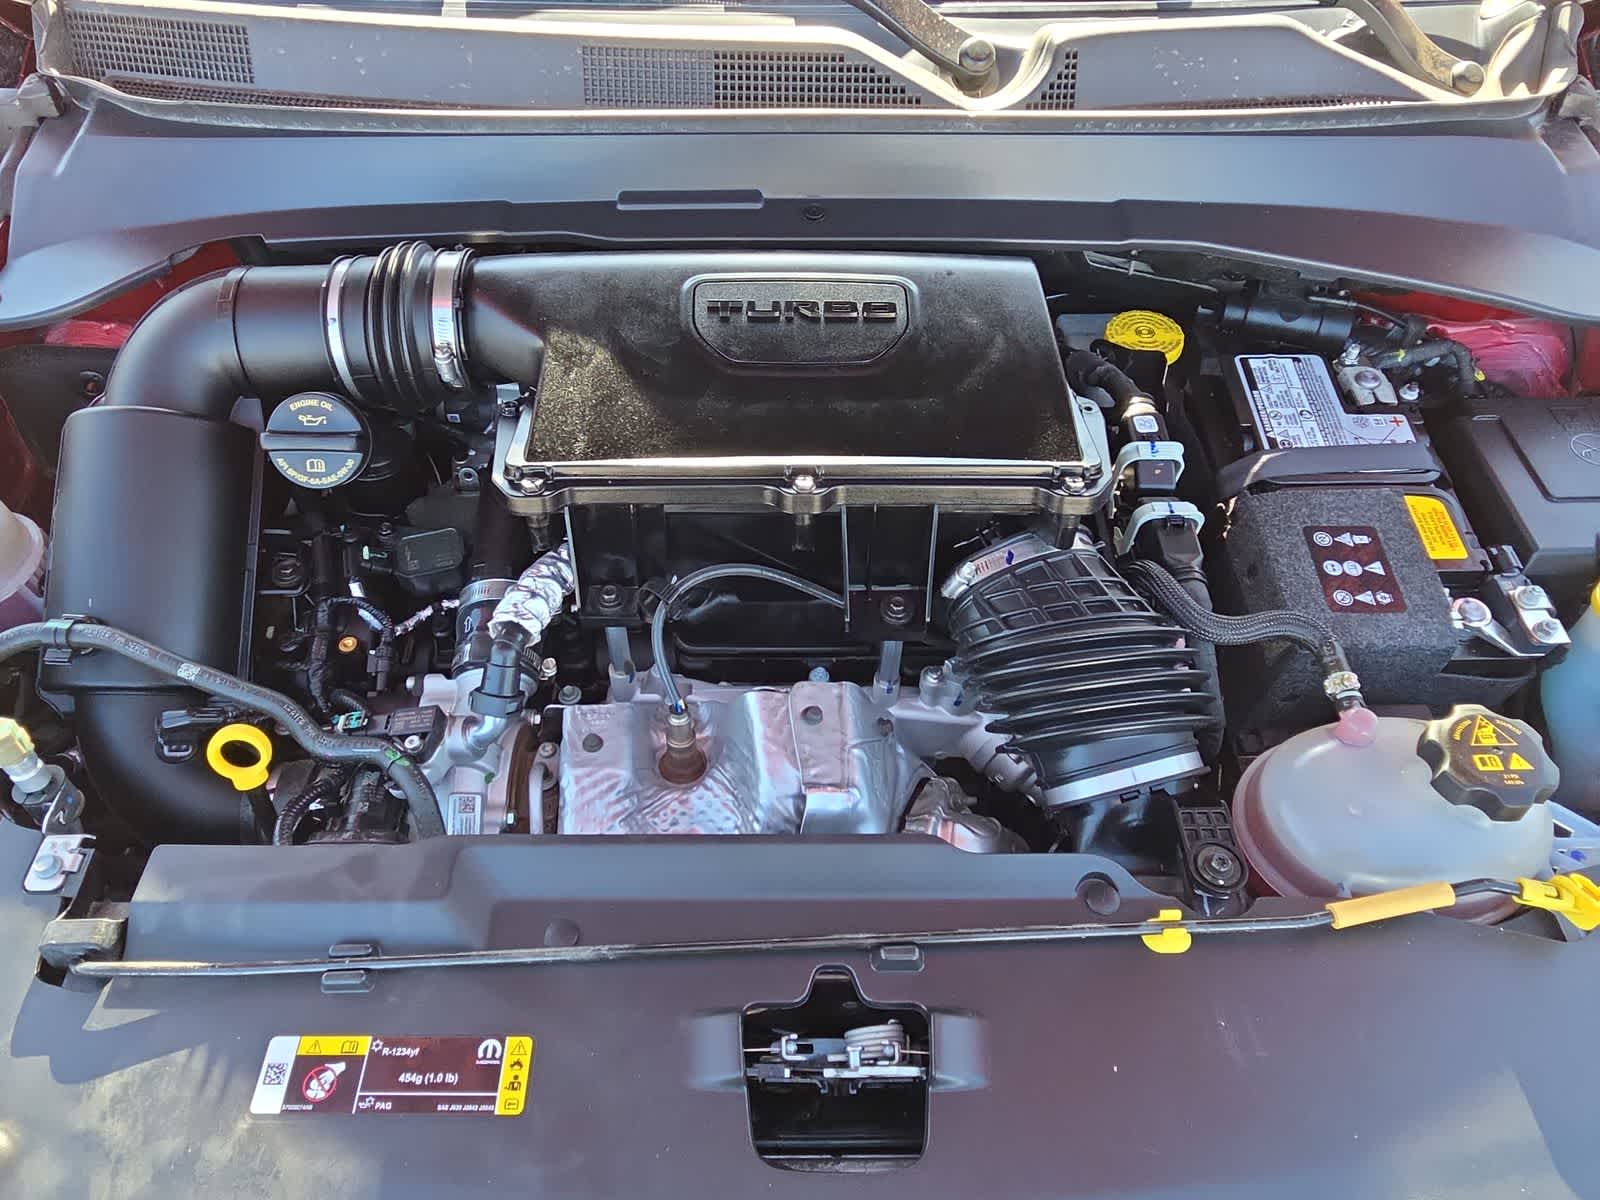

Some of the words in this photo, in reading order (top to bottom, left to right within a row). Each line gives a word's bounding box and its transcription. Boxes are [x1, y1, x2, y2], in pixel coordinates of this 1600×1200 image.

[706, 299, 898, 323] TURBO
[289, 399, 320, 411] ENGINE
[320, 401, 334, 411] OIL
[398, 1072, 423, 1085] 454g
[424, 1072, 443, 1085] (1.0
[444, 1072, 459, 1085] lb)
